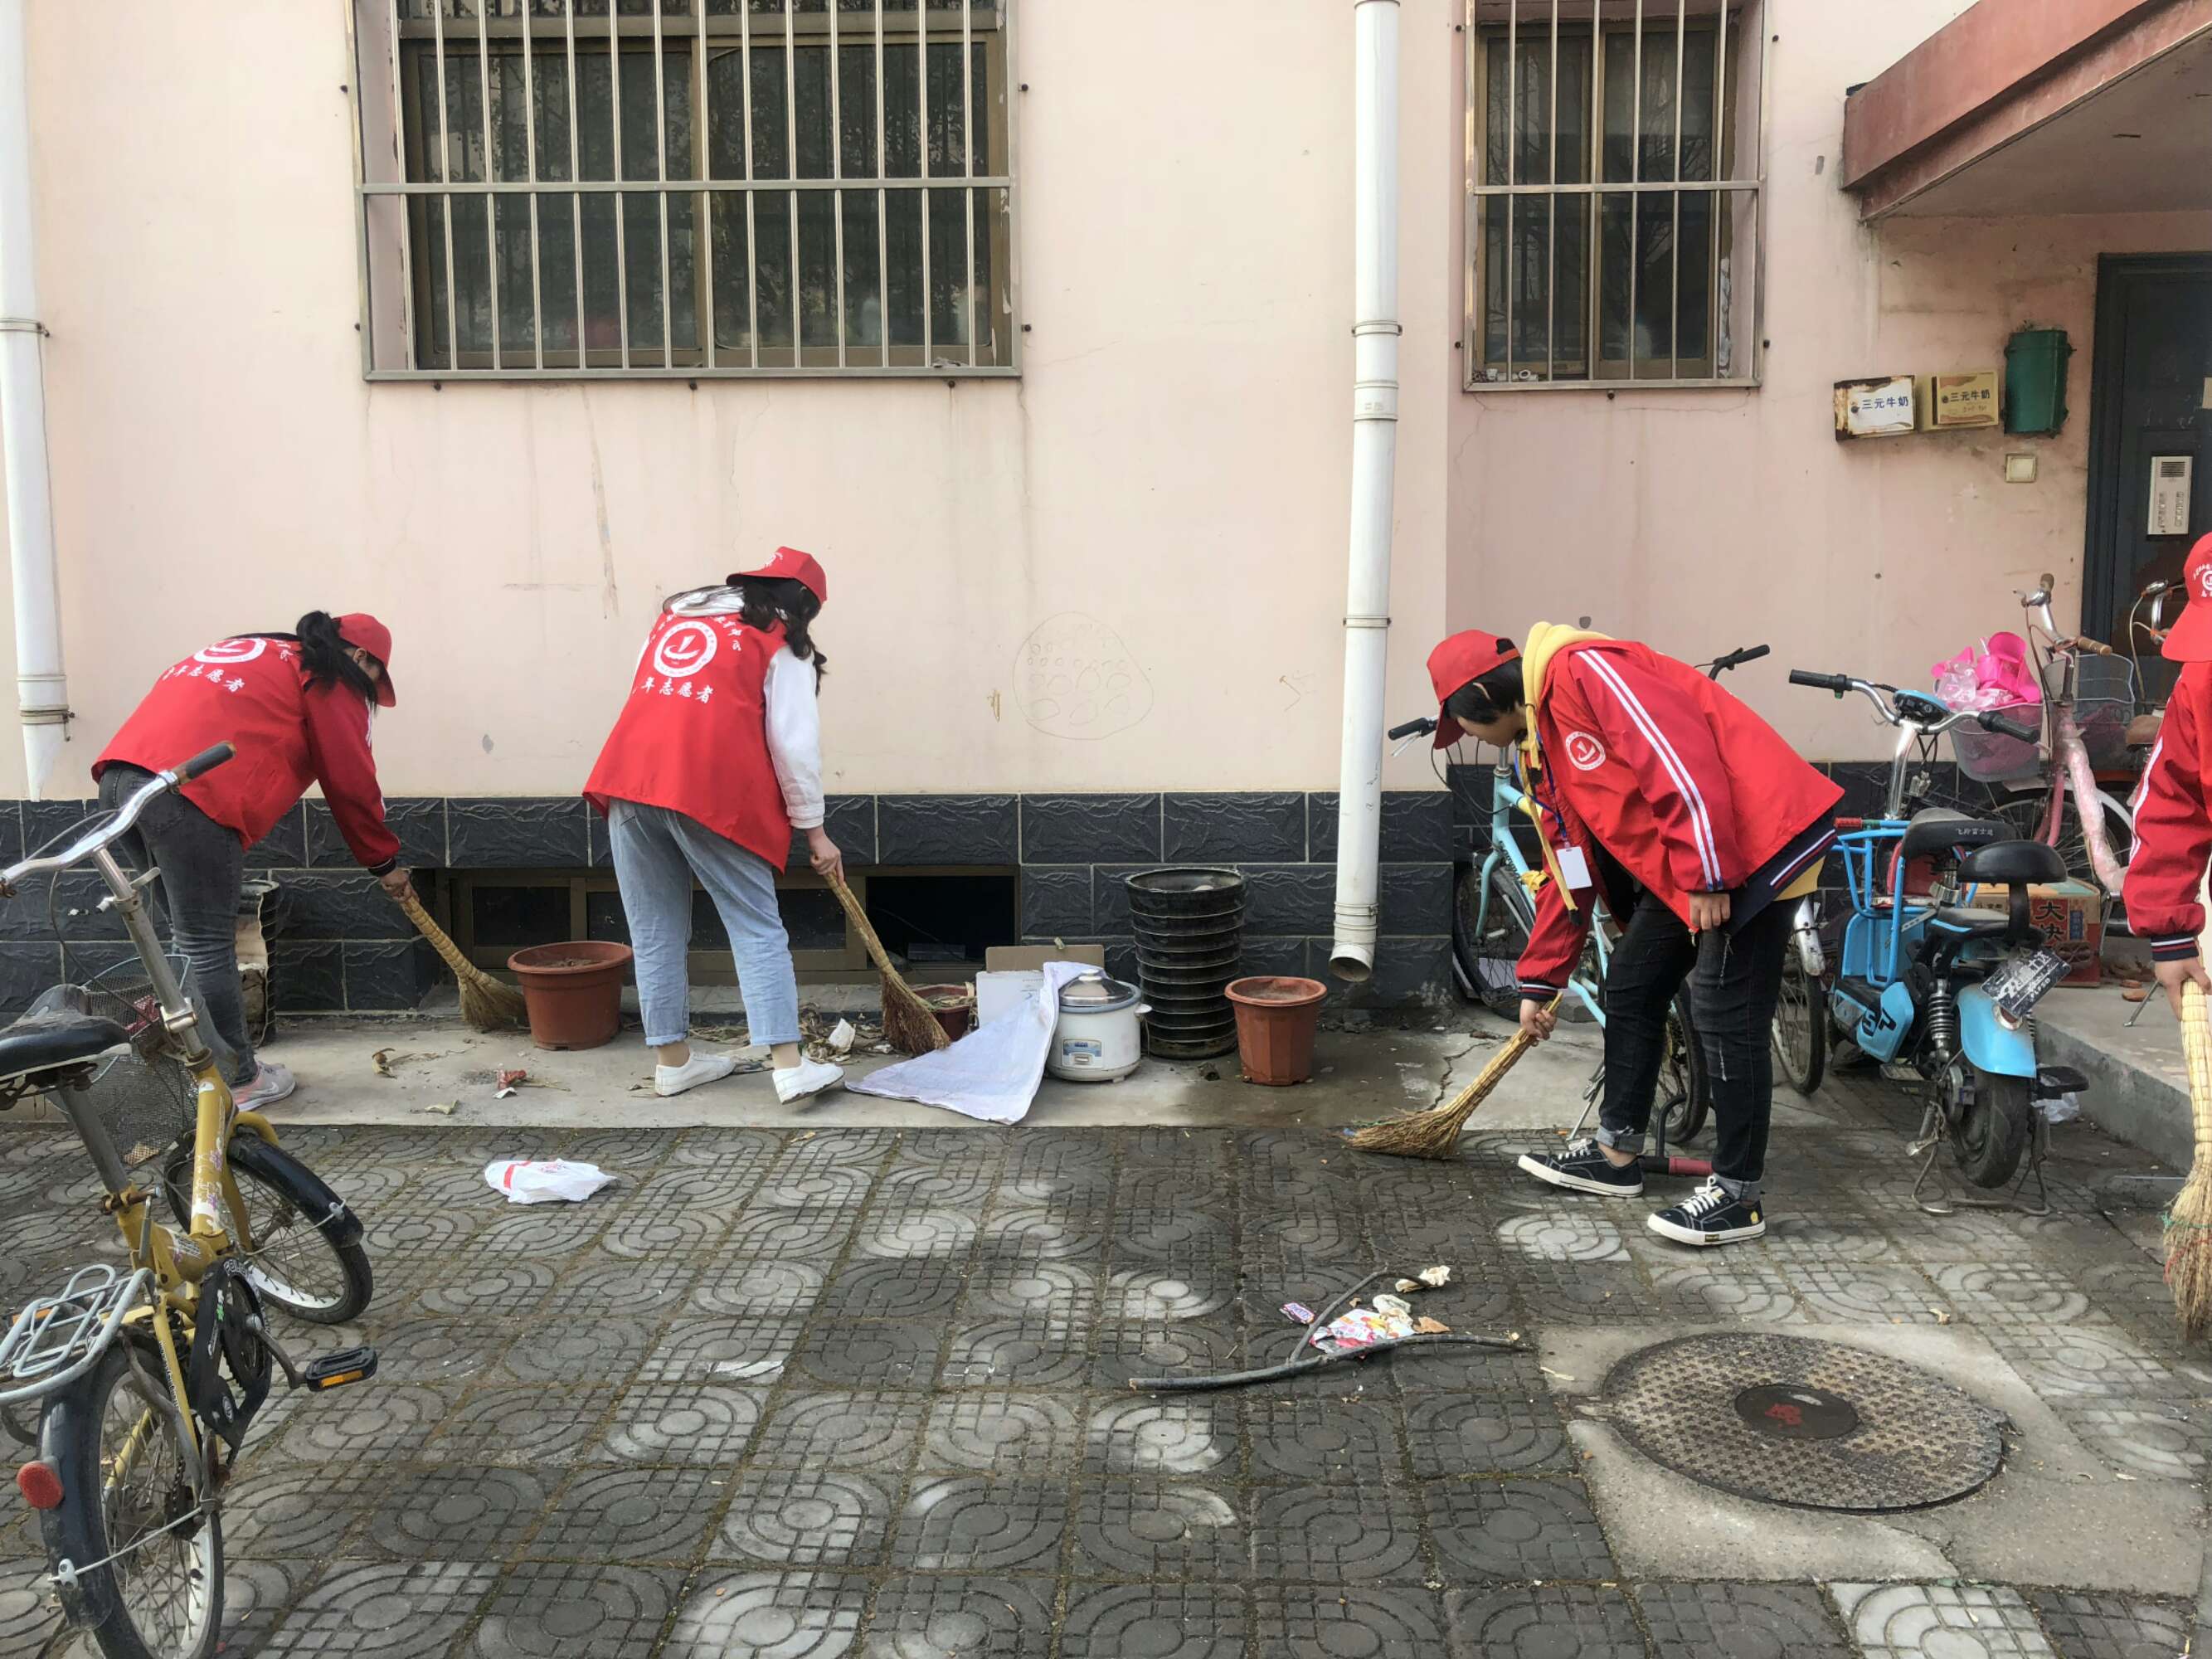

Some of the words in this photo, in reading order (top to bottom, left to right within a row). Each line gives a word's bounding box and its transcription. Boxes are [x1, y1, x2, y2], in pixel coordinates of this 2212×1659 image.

[1950, 389, 1991, 402] 三元牛奶
[1862, 396, 1909, 411] 三元牛奶
[632, 676, 714, 703] 年志愿者
